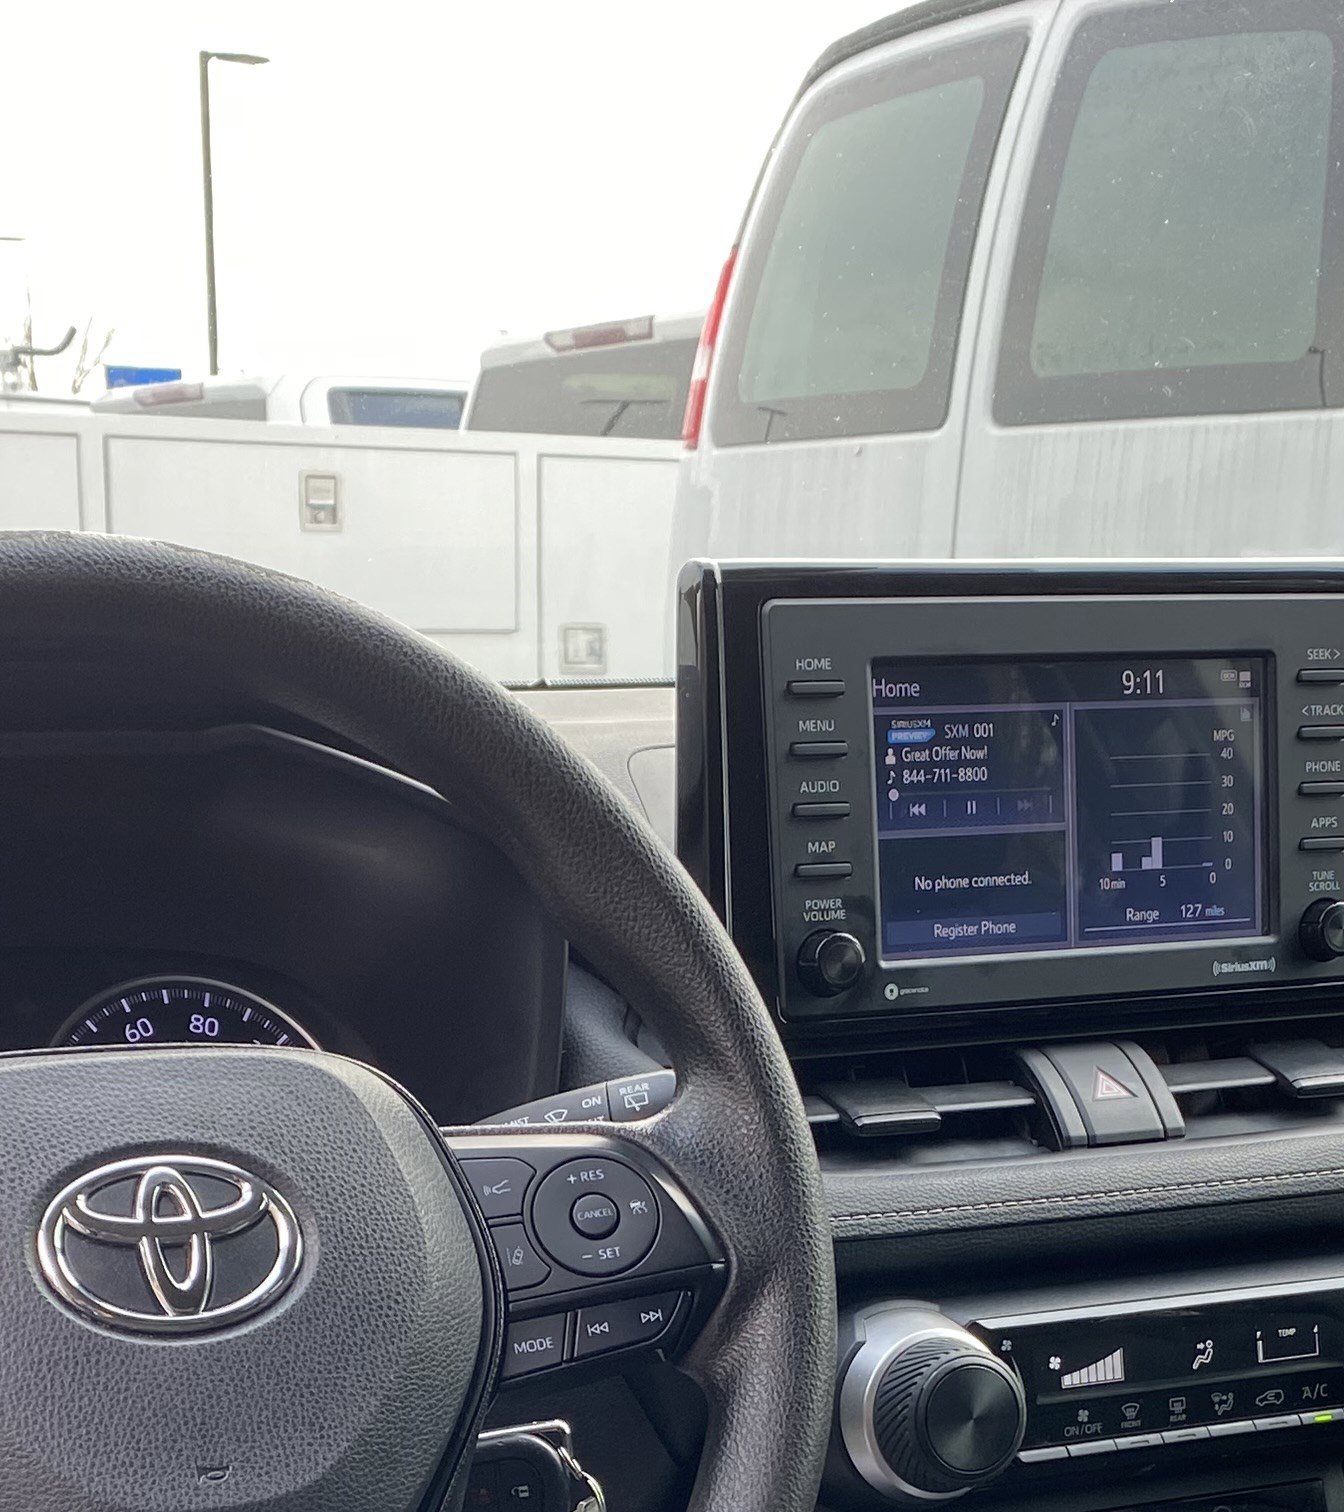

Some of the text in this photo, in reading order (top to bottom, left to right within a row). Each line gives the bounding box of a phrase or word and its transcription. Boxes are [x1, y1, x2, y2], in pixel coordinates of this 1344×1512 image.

[796, 658, 832, 670] HOME
[872, 678, 921, 698] Home
[1121, 669, 1164, 695] 9:11
[799, 720, 835, 732] MENU
[944, 723, 994, 739] SXM 001
[1213, 729, 1235, 742] MPG
[902, 745, 988, 762] Great Offer Now!
[1220, 748, 1233, 760] 40
[1306, 761, 1341, 772] PHONE
[902, 766, 988, 784] 844-711-8800
[1221, 775, 1234, 787] 30
[800, 780, 840, 793] AUDIO
[1221, 802, 1234, 815] 20
[1311, 817, 1338, 828] APPS
[1223, 830, 1234, 843] 10
[807, 841, 836, 853] MAP
[1224, 858, 1232, 870] 0
[914, 870, 1033, 893] No phone connected.
[1159, 875, 1166, 887] 5
[1209, 872, 1216, 884] 0
[1312, 871, 1334, 881] TUNE
[1309, 881, 1340, 892] SCROLL
[805, 898, 843, 910] POWER
[803, 909, 847, 922] VOLUME
[1125, 904, 1225, 923] Range 127 miles
[933, 921, 1017, 940] Register Phone
[125, 1018, 154, 1042] 60
[189, 1014, 219, 1037] 80
[619, 1082, 650, 1096] REAR
[581, 1095, 602, 1109] ON
[580, 1169, 605, 1182] RES
[577, 1208, 613, 1221] CANCEL
[598, 1246, 621, 1259] SET
[1278, 1328, 1296, 1338] TEMP
[513, 1336, 554, 1355] MODE
[1302, 1383, 1328, 1399] A/C
[1121, 1420, 1142, 1429] FRONT
[1169, 1414, 1187, 1422] REAR
[1064, 1422, 1103, 1437] ON/OFF
